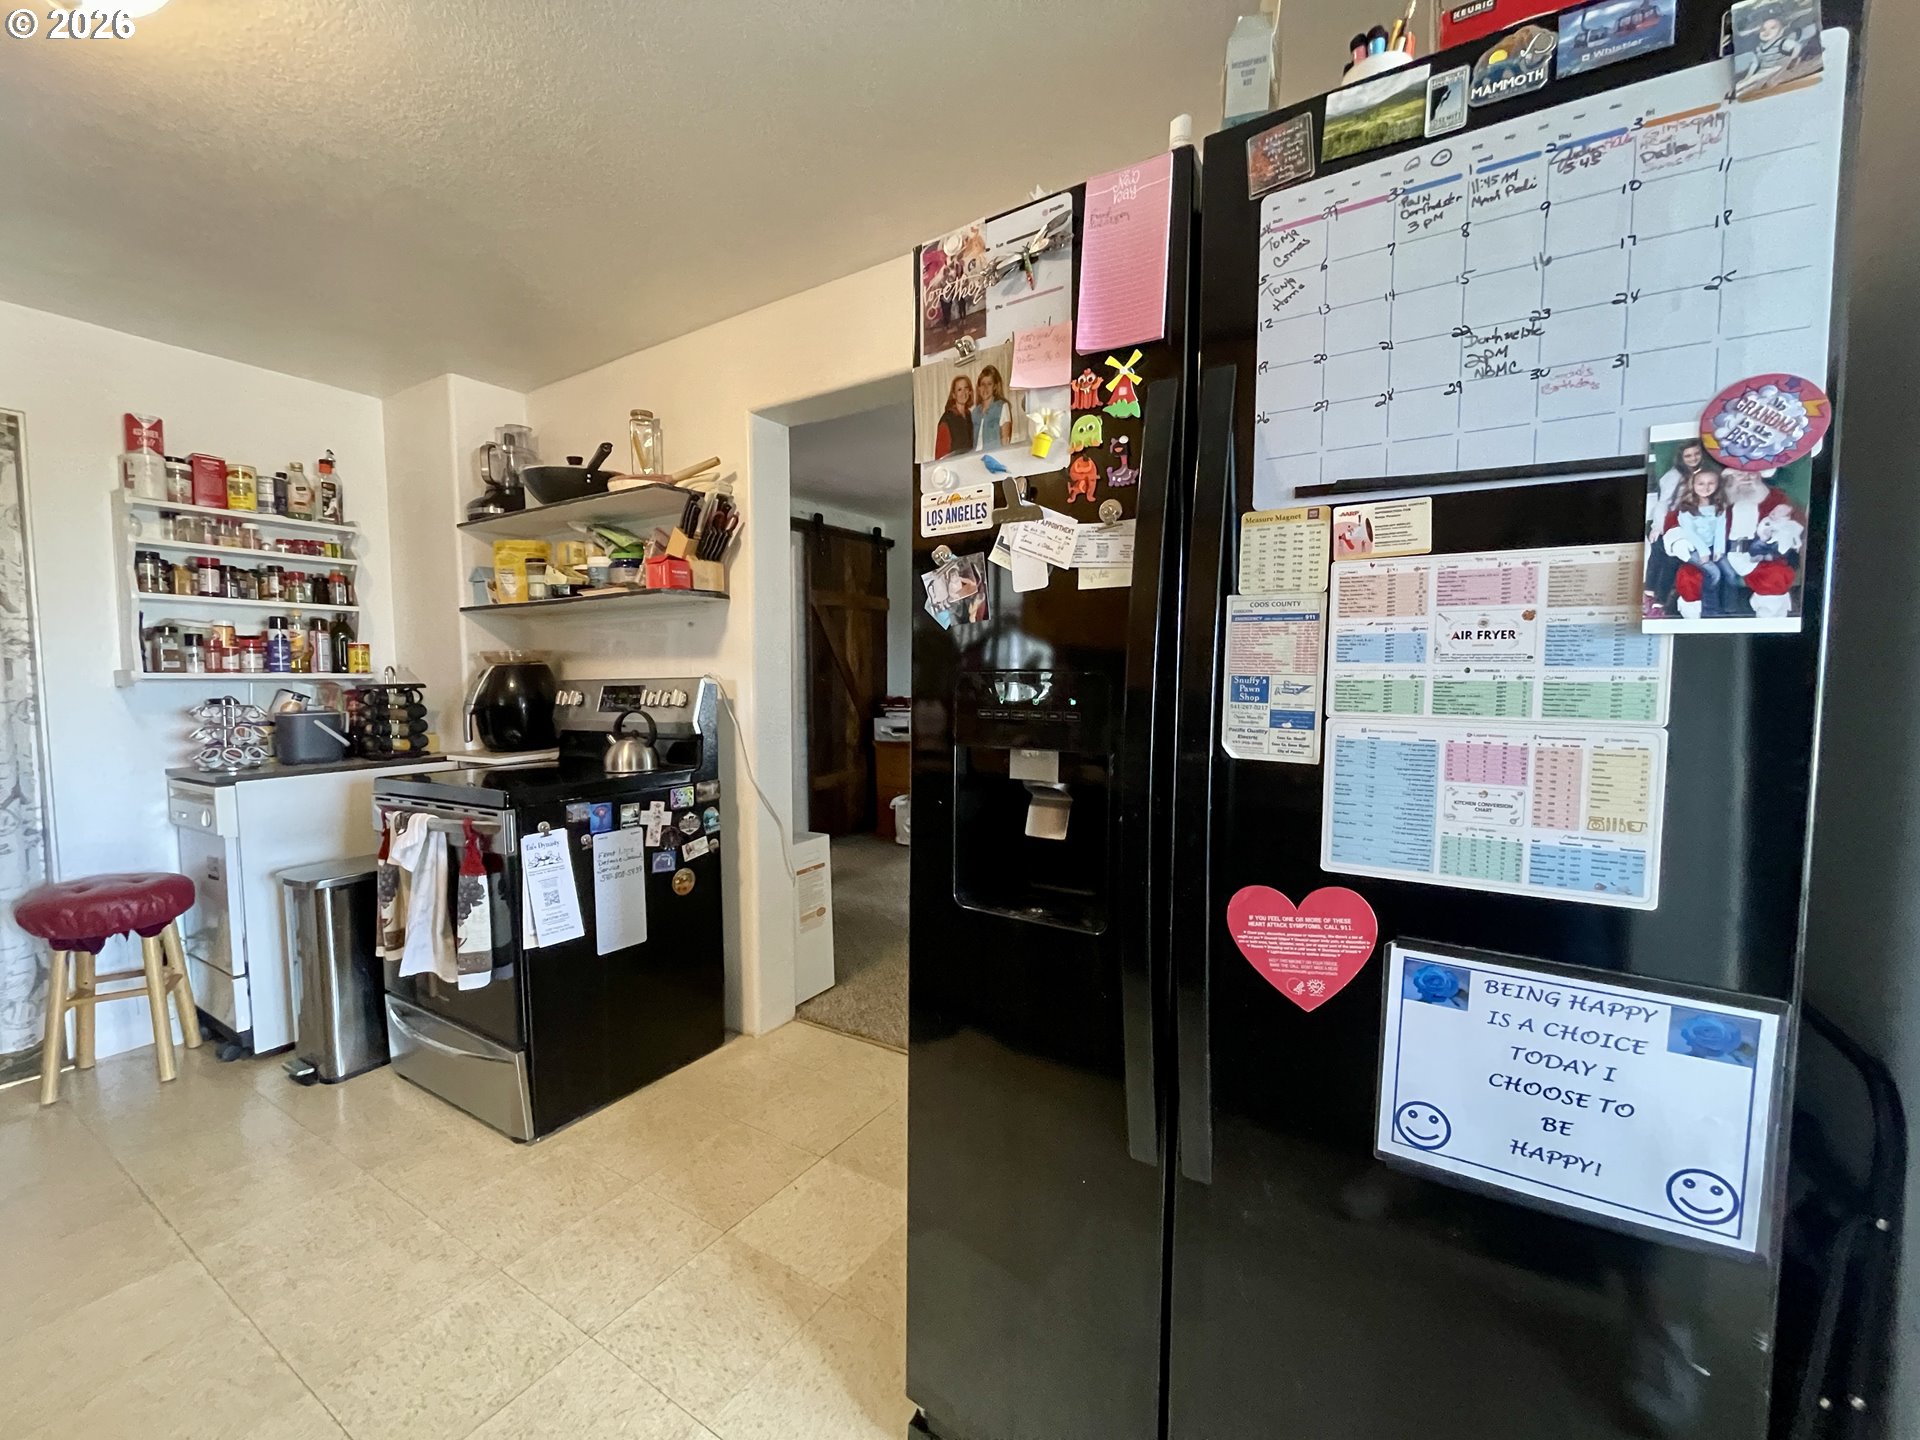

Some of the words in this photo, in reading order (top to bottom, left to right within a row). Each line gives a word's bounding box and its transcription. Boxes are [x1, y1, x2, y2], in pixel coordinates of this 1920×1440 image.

[1452, 0, 1495, 19] KEURIG
[1593, 38, 1645, 58] Whistler
[1471, 68, 1544, 99] MAMMOTH
[1630, 117, 1644, 131] 3
[1718, 156, 1733, 172] 11
[1622, 179, 1642, 193] 10
[1539, 200, 1551, 218] 9
[1714, 209, 1733, 228] 18
[1407, 221, 1419, 233] 3
[1460, 221, 1471, 238] 8
[1387, 242, 1396, 255] 7
[1620, 234, 1637, 249] 17
[1320, 257, 1329, 272] 6
[1533, 252, 1552, 271] 16
[1259, 273, 1270, 286] 5
[1456, 269, 1476, 284] 15
[1384, 288, 1397, 302] 14
[1611, 289, 1640, 304] 24
[1318, 303, 1332, 316] 13
[1529, 308, 1551, 322] 23
[1260, 318, 1273, 331] 12
[1451, 325, 1471, 338] 22
[1378, 340, 1394, 351] 21
[1313, 353, 1328, 364] 20
[1611, 353, 1630, 369] 31
[1258, 360, 1269, 374] 19
[1529, 367, 1551, 380] 30
[1443, 381, 1463, 397] 29
[1374, 388, 1394, 408] 28
[1313, 399, 1329, 413] 27
[1256, 410, 1270, 424] 26
[1726, 427, 1767, 453] BEST
[926, 509, 943, 527] LOS
[945, 502, 988, 524] ANGELES
[1275, 513, 1302, 522] Magnet
[1041, 519, 1075, 536] APPOINTMENT
[1451, 630, 1473, 640] AIR
[1476, 630, 1516, 640] FRYER
[1233, 676, 1267, 686] Snuffy's
[1239, 684, 1260, 692] Pawn
[1239, 692, 1260, 702] Shop
[1484, 979, 1562, 1007] BEING
[1568, 993, 1659, 1024] HAPPY
[1486, 1010, 1512, 1028] IS
[1517, 1016, 1535, 1033] A
[1543, 1021, 1650, 1056] CHOICE
[1509, 1045, 1598, 1078] TODAY
[1601, 1066, 1618, 1083] I
[1488, 1072, 1592, 1110] CHOOSE
[1599, 1097, 1636, 1119] TO
[1540, 1116, 1575, 1137] BE
[1509, 1139, 1603, 1178] HAPPY!
